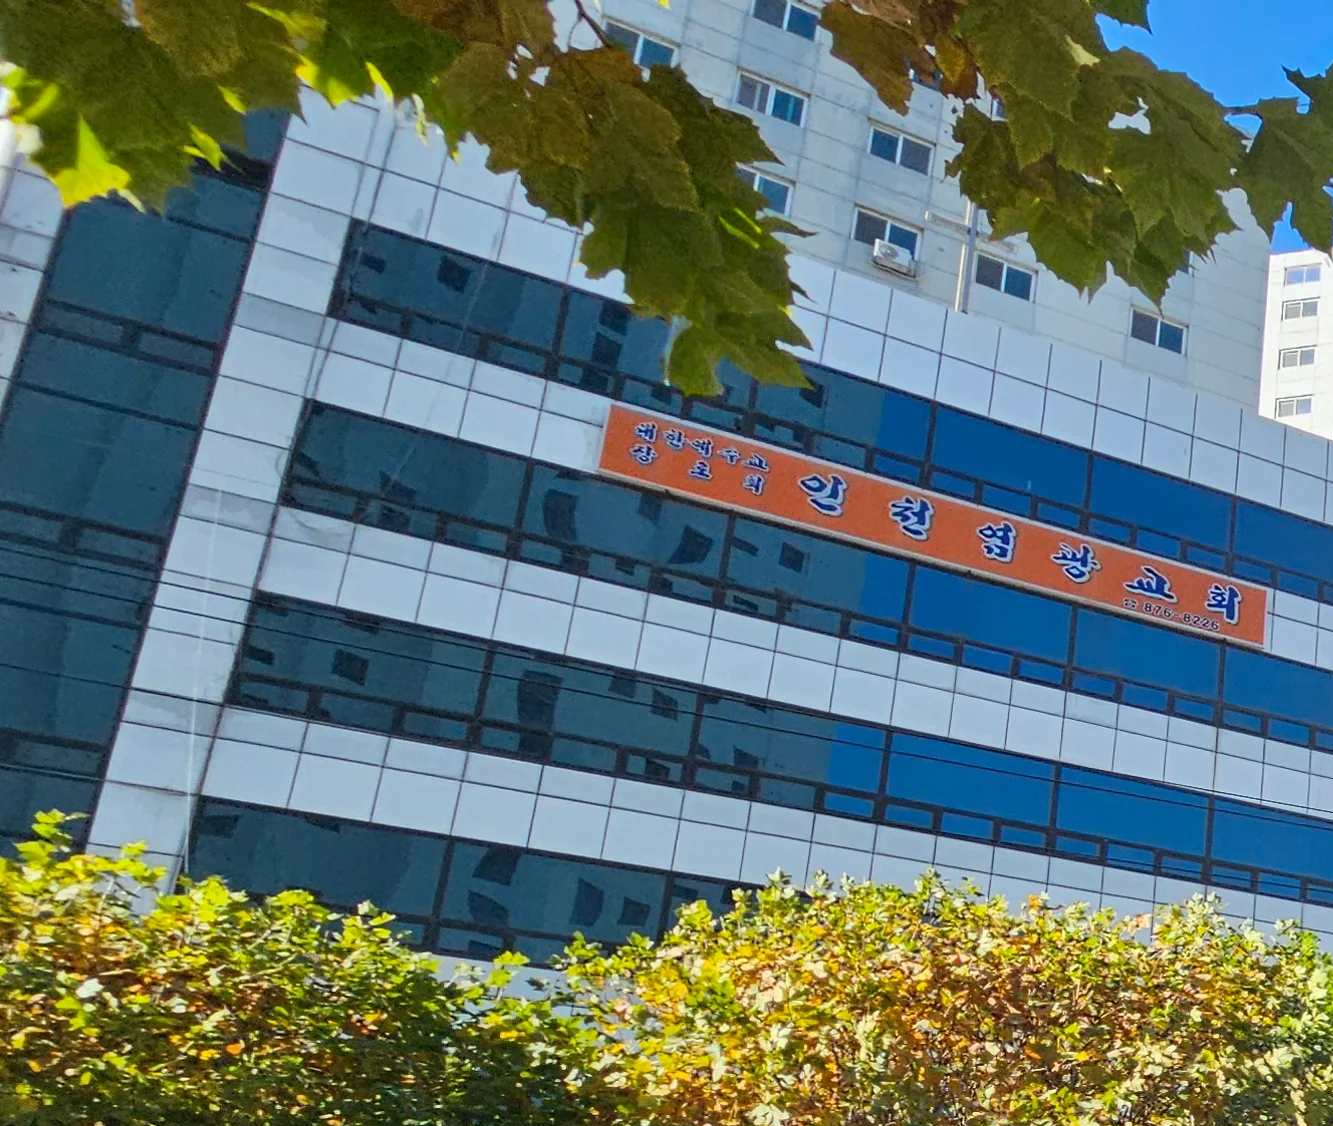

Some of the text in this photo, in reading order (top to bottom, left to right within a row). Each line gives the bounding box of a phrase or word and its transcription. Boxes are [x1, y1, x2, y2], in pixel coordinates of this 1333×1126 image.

[629, 444, 766, 496] 장로회
[633, 421, 771, 474] 대한예수교
[1143, 601, 1221, 632] 876-8226
